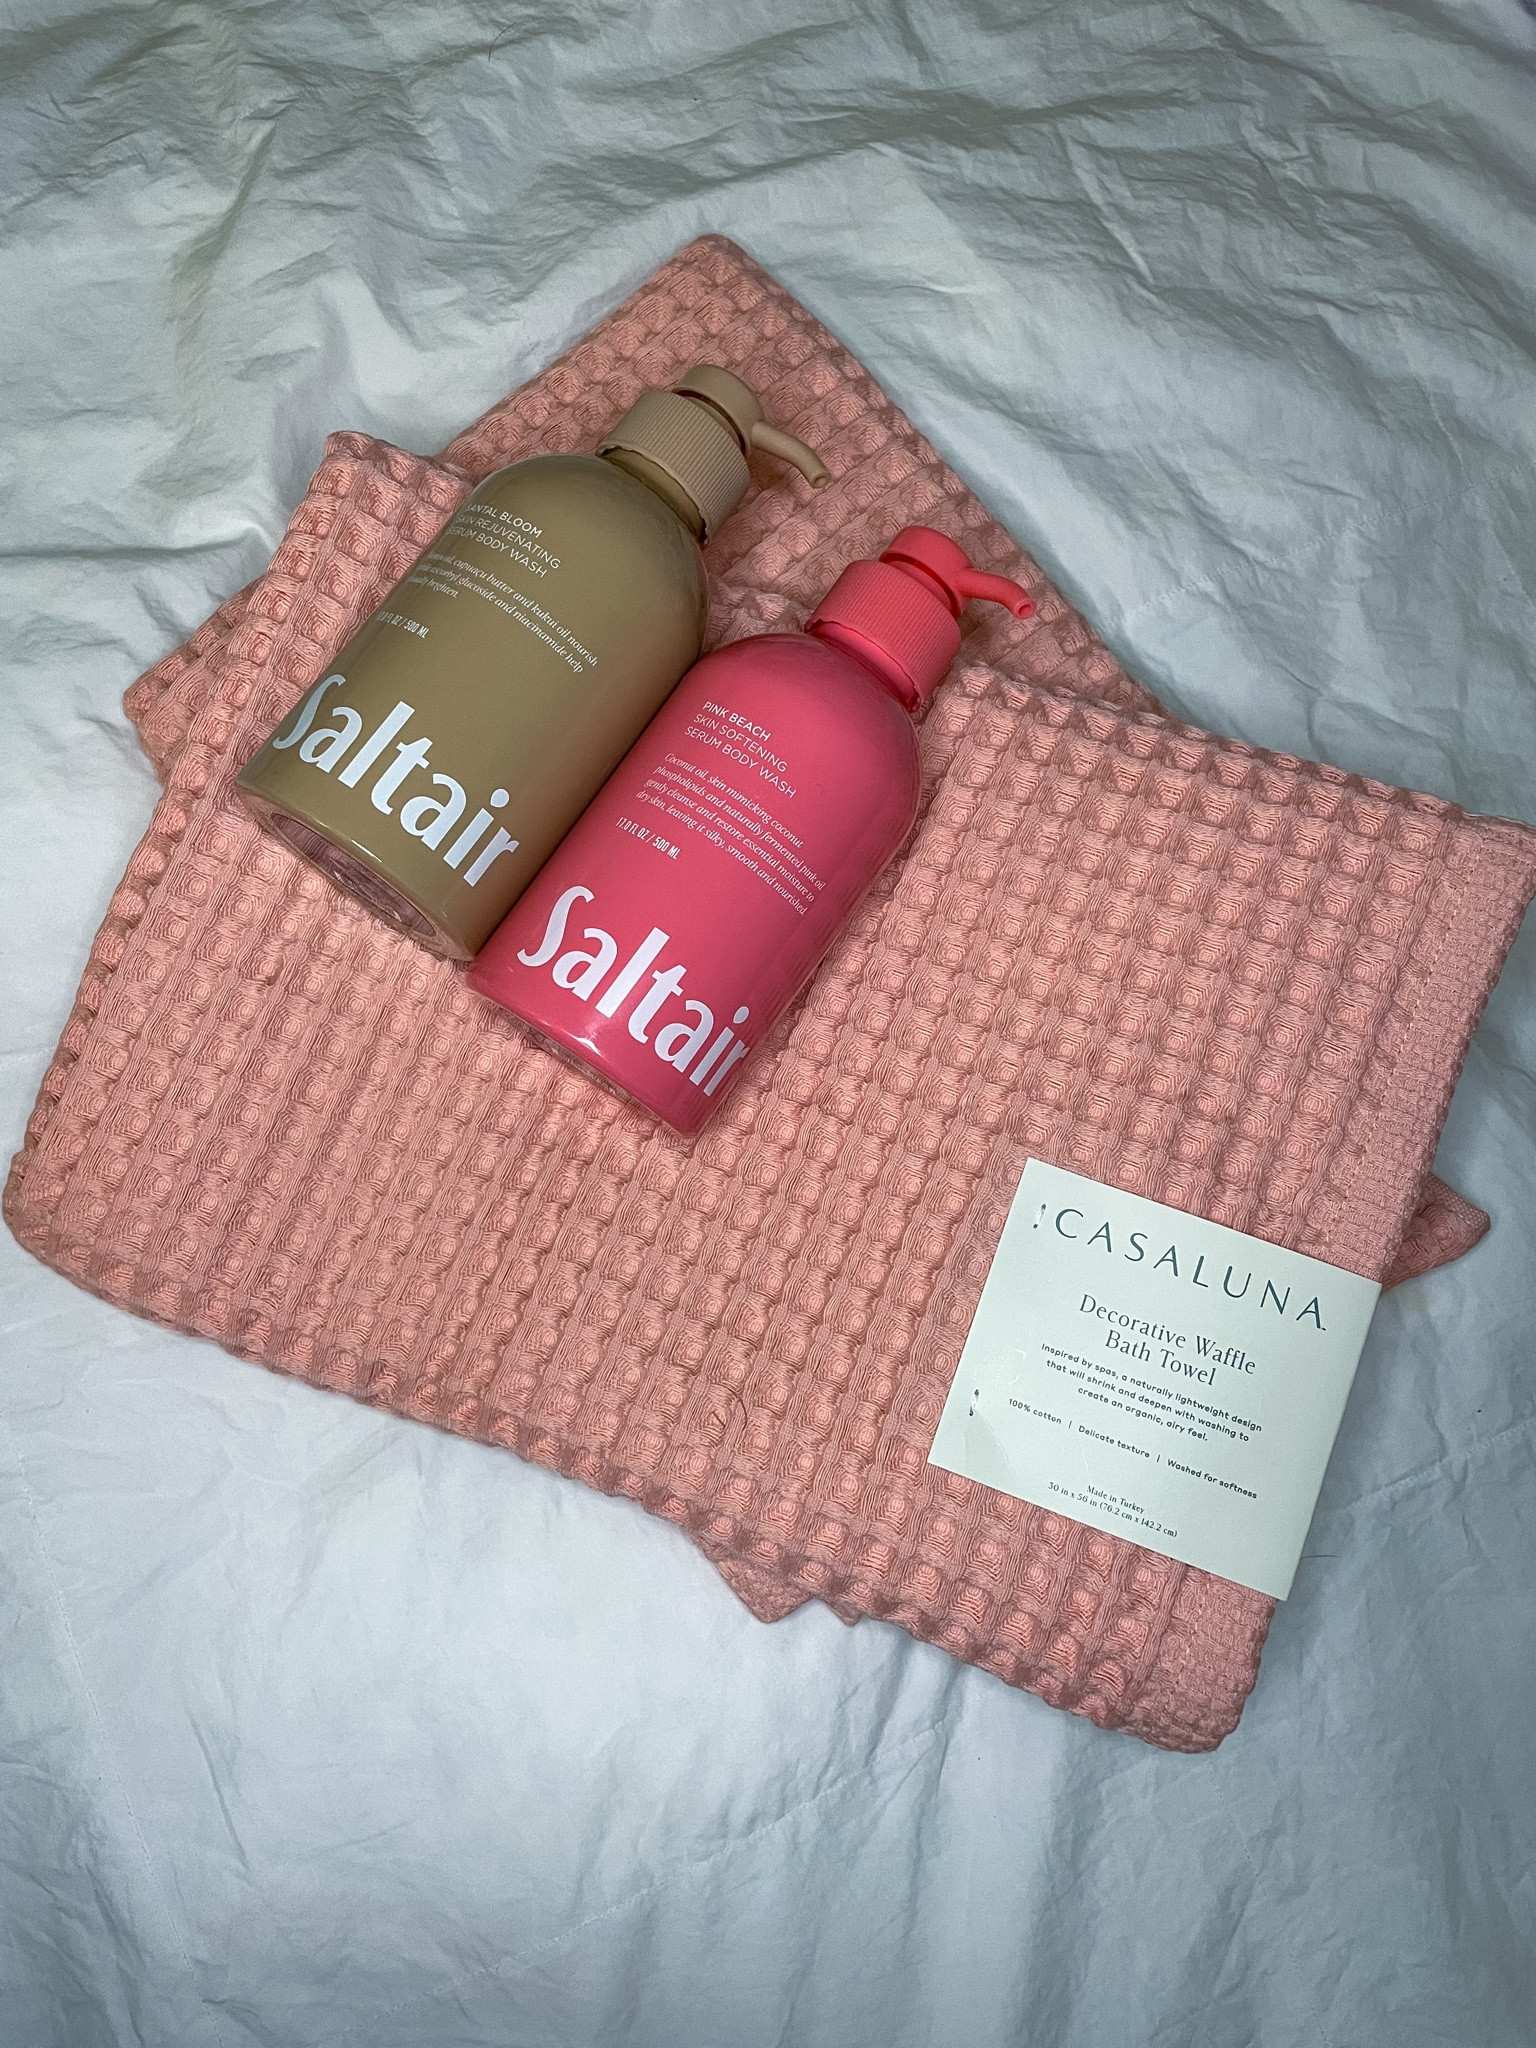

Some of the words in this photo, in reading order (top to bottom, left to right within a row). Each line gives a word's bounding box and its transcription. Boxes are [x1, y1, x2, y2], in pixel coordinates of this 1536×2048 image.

[447, 526, 476, 538] SERUM
[476, 533, 509, 552] BODY
[509, 548, 547, 578] WASH
[457, 514, 475, 525] SKIN
[476, 518, 561, 568] REJUVENATING
[466, 504, 497, 517] SANTAL
[500, 512, 543, 538] BLOOM
[404, 619, 420, 633] 500
[416, 625, 430, 638] ML
[458, 574, 496, 601] glucoside
[494, 599, 517, 614] and
[513, 611, 567, 656] niacinamide
[565, 653, 584, 673] help
[486, 573, 515, 595] butter
[513, 591, 535, 608] and
[531, 604, 560, 628] kukui
[556, 625, 571, 638] oil
[567, 636, 598, 667] nourish
[693, 713, 719, 730] SKIN
[719, 725, 788, 772] SOFTENING
[702, 701, 729, 718] PINK
[728, 713, 771, 742] BEACH
[272, 674, 520, 887] Saltair
[685, 726, 722, 749] SERUM
[722, 744, 758, 769] BODY
[759, 765, 797, 799] WASH
[652, 766, 707, 797] phospholipids
[705, 792, 726, 808] and
[722, 803, 764, 836] naturally
[760, 831, 805, 869] fermented
[798, 865, 818, 882] pink
[814, 880, 826, 891] oil
[664, 753, 696, 772] Coconut
[708, 775, 727, 791] skin
[725, 787, 772, 825] mimicking
[771, 819, 804, 848] coconut
[616, 817, 631, 831] 17.0
[628, 822, 639, 835] FL
[637, 827, 650, 840] OZ
[645, 834, 656, 843] /
[652, 836, 670, 852] 500
[667, 845, 681, 860] ML
[636, 790, 650, 802] dry
[666, 804, 698, 829] leaving
[696, 822, 705, 833] it
[703, 828, 725, 848] silky,
[725, 844, 759, 872] smooth
[757, 868, 777, 885] and
[773, 882, 808, 916] nourished.
[644, 779, 668, 793] gently
[667, 788, 697, 809] cleanse
[696, 806, 717, 821] and
[713, 817, 744, 840] restore
[742, 838, 781, 868] essential
[777, 865, 808, 895] moisture
[805, 892, 815, 902] to
[517, 885, 750, 1097] Saltair
[1055, 1208, 1323, 1330] CASALUNA
[1079, 1294, 1187, 1349] Decorative
[1196, 1335, 1256, 1375] Waffle
[1105, 1329, 1151, 1362] Bath
[1160, 1349, 1217, 1386] Towel
[1046, 1359, 1067, 1373] that
[1069, 1367, 1085, 1379] will
[1086, 1375, 1116, 1392] shrink
[1118, 1387, 1137, 1399] and
[1138, 1393, 1172, 1413] deepen
[1174, 1406, 1196, 1422] with
[1198, 1417, 1236, 1439] washing
[1239, 1431, 1250, 1442] to
[1078, 1386, 1109, 1403] create
[1111, 1399, 1123, 1409] an
[1125, 1404, 1164, 1426] organic,
[1166, 1420, 1186, 1433] airy
[1187, 1426, 1208, 1442] feel.
[1081, 1357, 1093, 1369] by
[1094, 1363, 1119, 1380] spas,
[1121, 1374, 1128, 1382] a
[1130, 1377, 1173, 1400] naturally
[1175, 1392, 1230, 1420] lightweight
[1231, 1413, 1262, 1432] design
[1008, 1398, 1031, 1412] 100%
[1032, 1407, 1062, 1425] cotton
[1078, 1424, 1115, 1445] Delicate
[1117, 1439, 1150, 1458] texture
[1167, 1458, 1202, 1478] Washed
[1203, 1472, 1217, 1485] for
[1219, 1479, 1258, 1499] softness
[1047, 1481, 1059, 1492] 30
[1060, 1487, 1069, 1496] in
[1077, 1492, 1088, 1503] 56
[1089, 1498, 1098, 1508] in
[1099, 1502, 1120, 1516] (76.2
[1121, 1511, 1133, 1521] cm
[1140, 1517, 1162, 1532] 142.2
[1163, 1525, 1178, 1538] cm)
[1087, 1485, 1108, 1499] Made
[1109, 1495, 1117, 1503] in
[1120, 1497, 1146, 1514] Turkey
